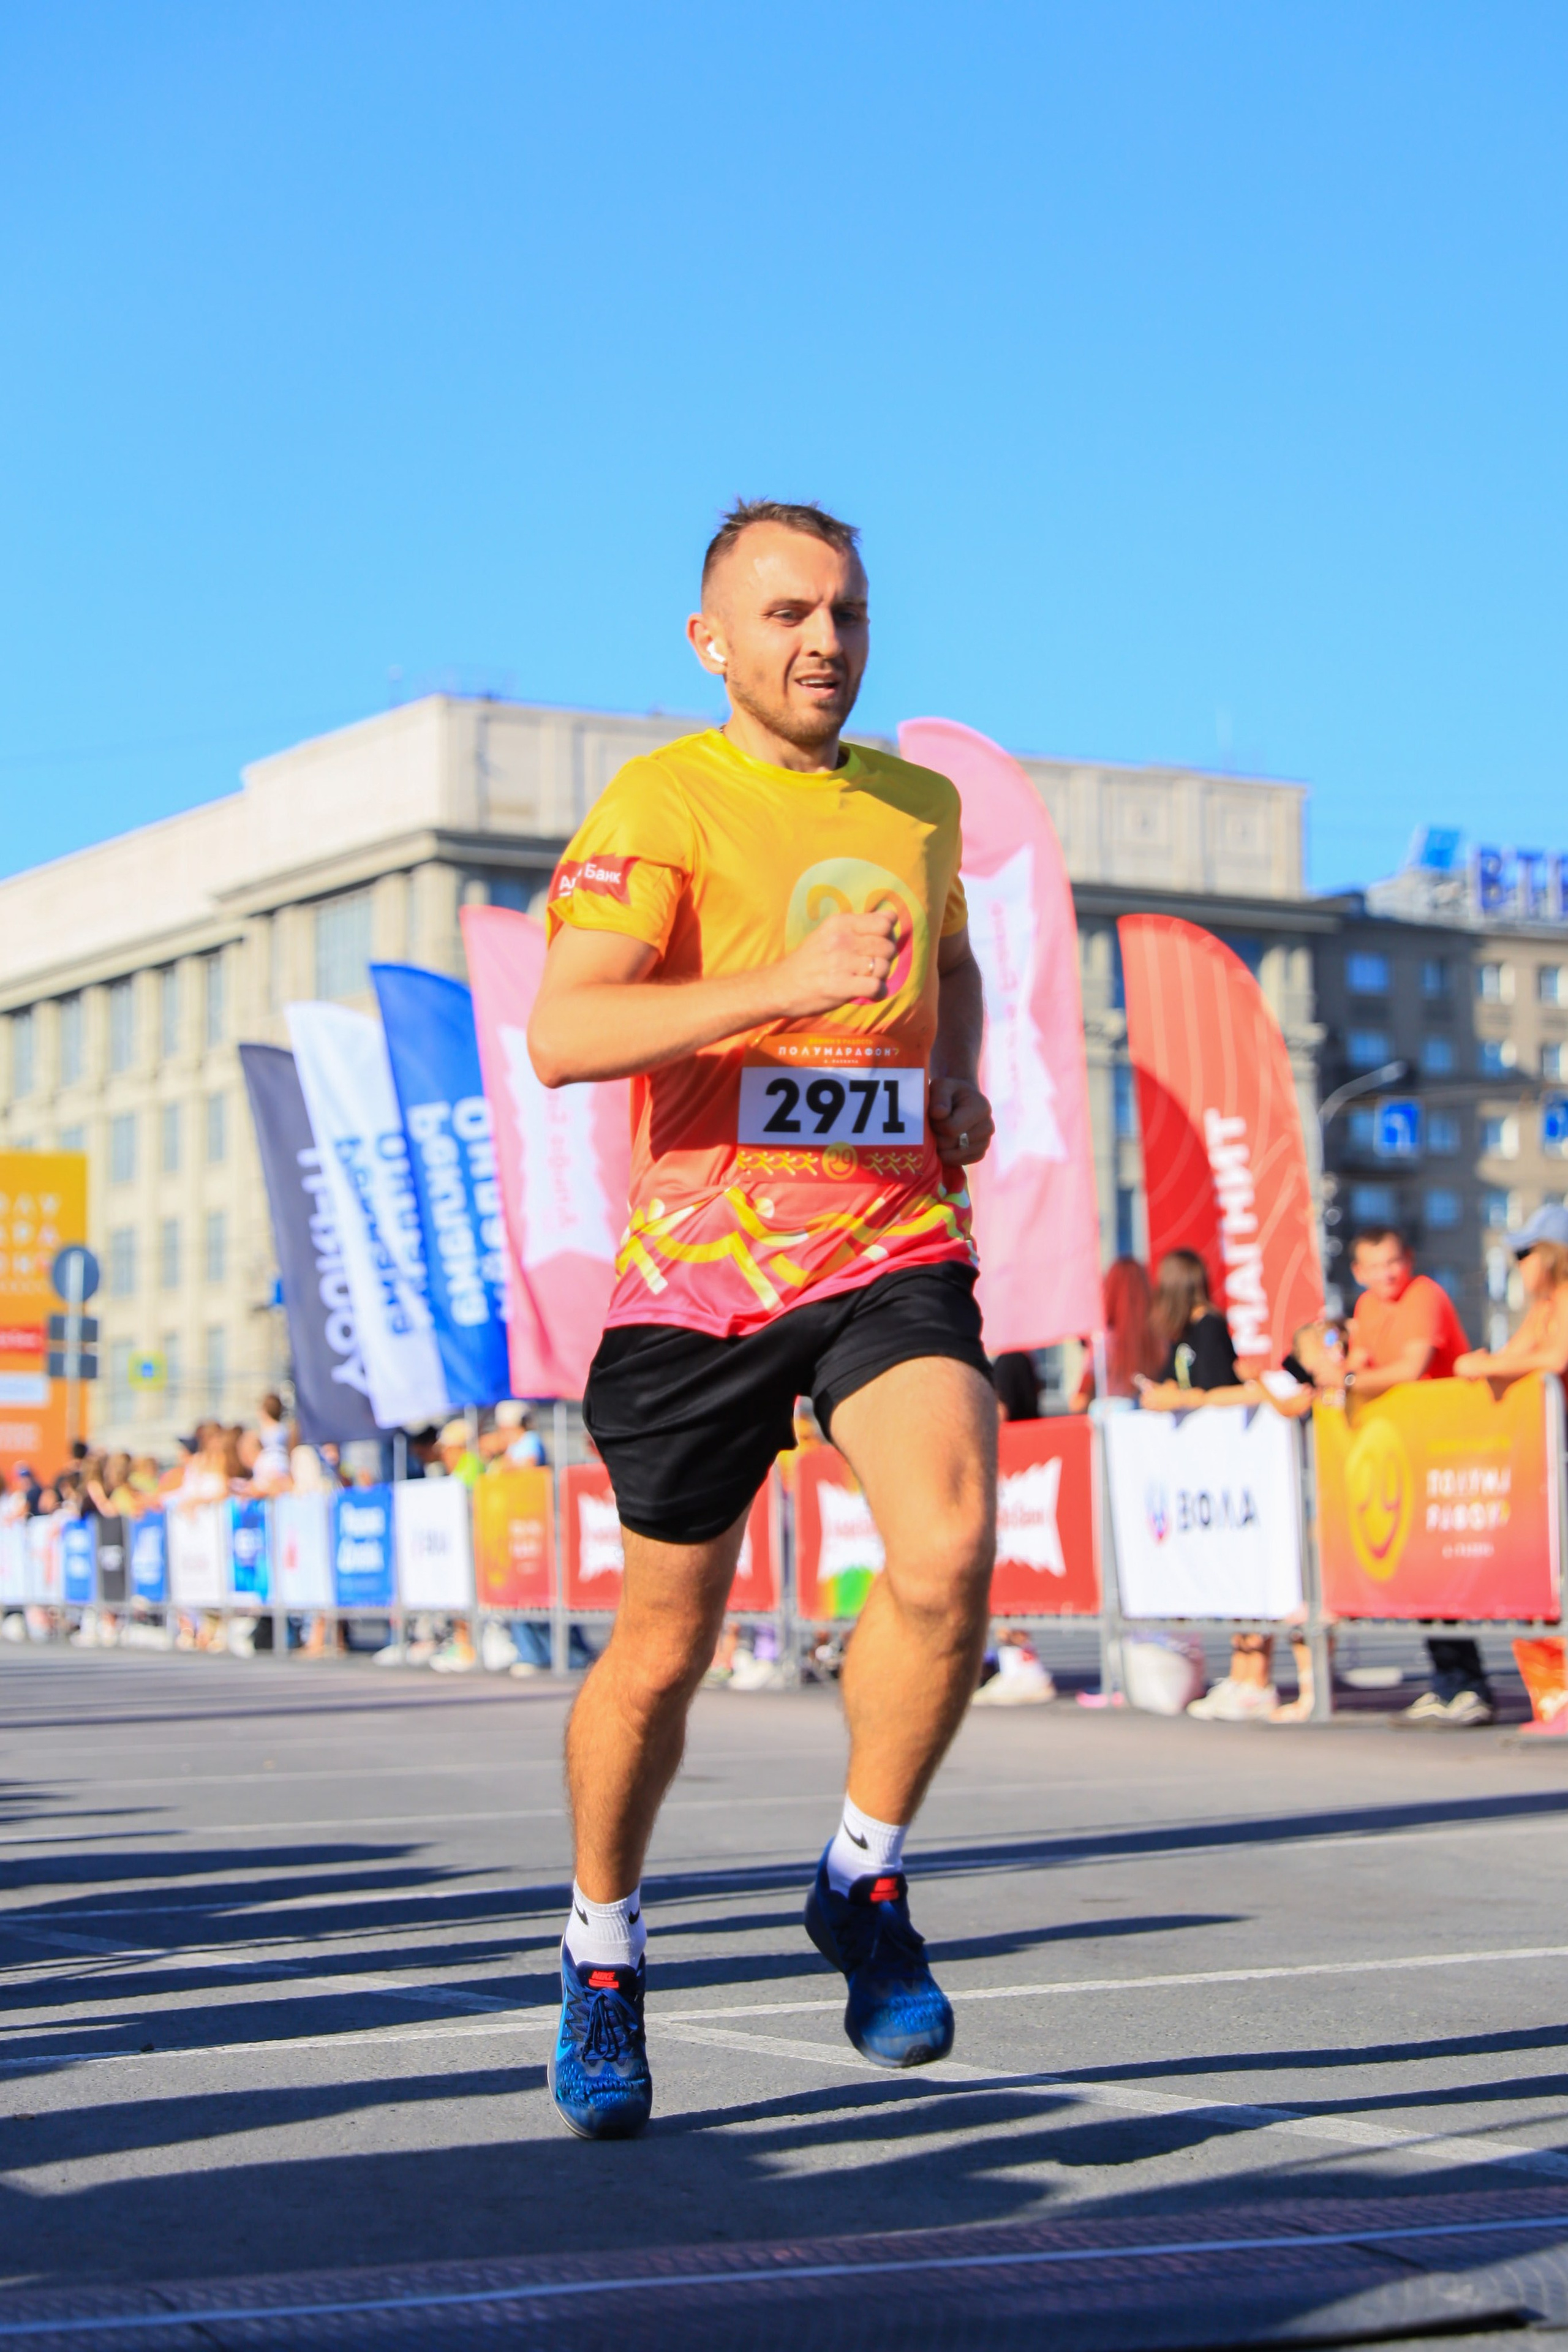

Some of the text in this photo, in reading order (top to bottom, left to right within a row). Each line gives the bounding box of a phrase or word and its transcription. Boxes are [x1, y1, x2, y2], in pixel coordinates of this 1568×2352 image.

[584, 862, 621, 884] Банк
[1471, 844, 1568, 915] ВТ
[778, 1046, 891, 1057] ПОЛУМАРАФОН
[763, 1077, 905, 1134] 2971
[1204, 1107, 1272, 1356] МАГНИТ
[592, 1970, 616, 1981] NIKE
